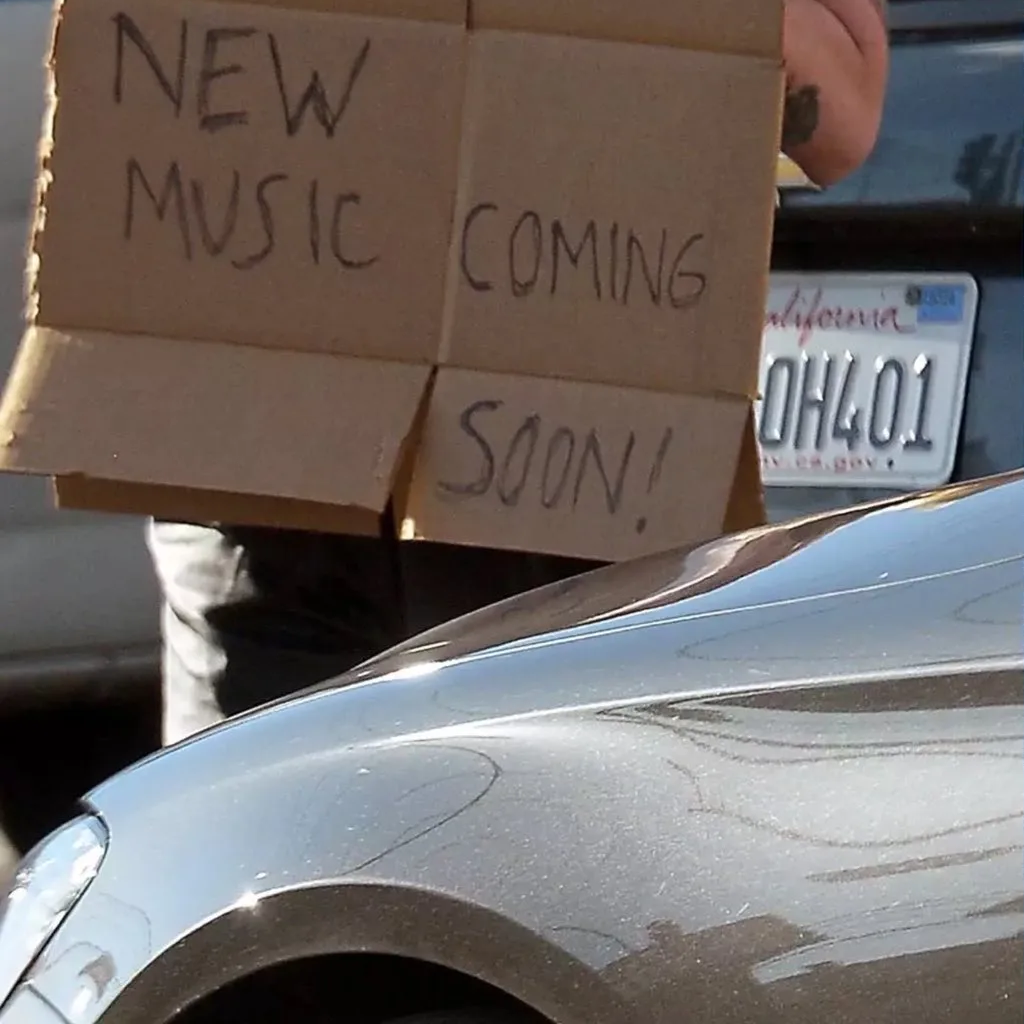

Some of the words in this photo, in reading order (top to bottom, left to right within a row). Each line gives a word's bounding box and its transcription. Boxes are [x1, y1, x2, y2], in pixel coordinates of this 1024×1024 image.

[110, 11, 371, 139] NEW
[123, 157, 381, 270] MUSIC
[460, 203, 707, 310] COMING
[437, 400, 674, 535] SOON!
